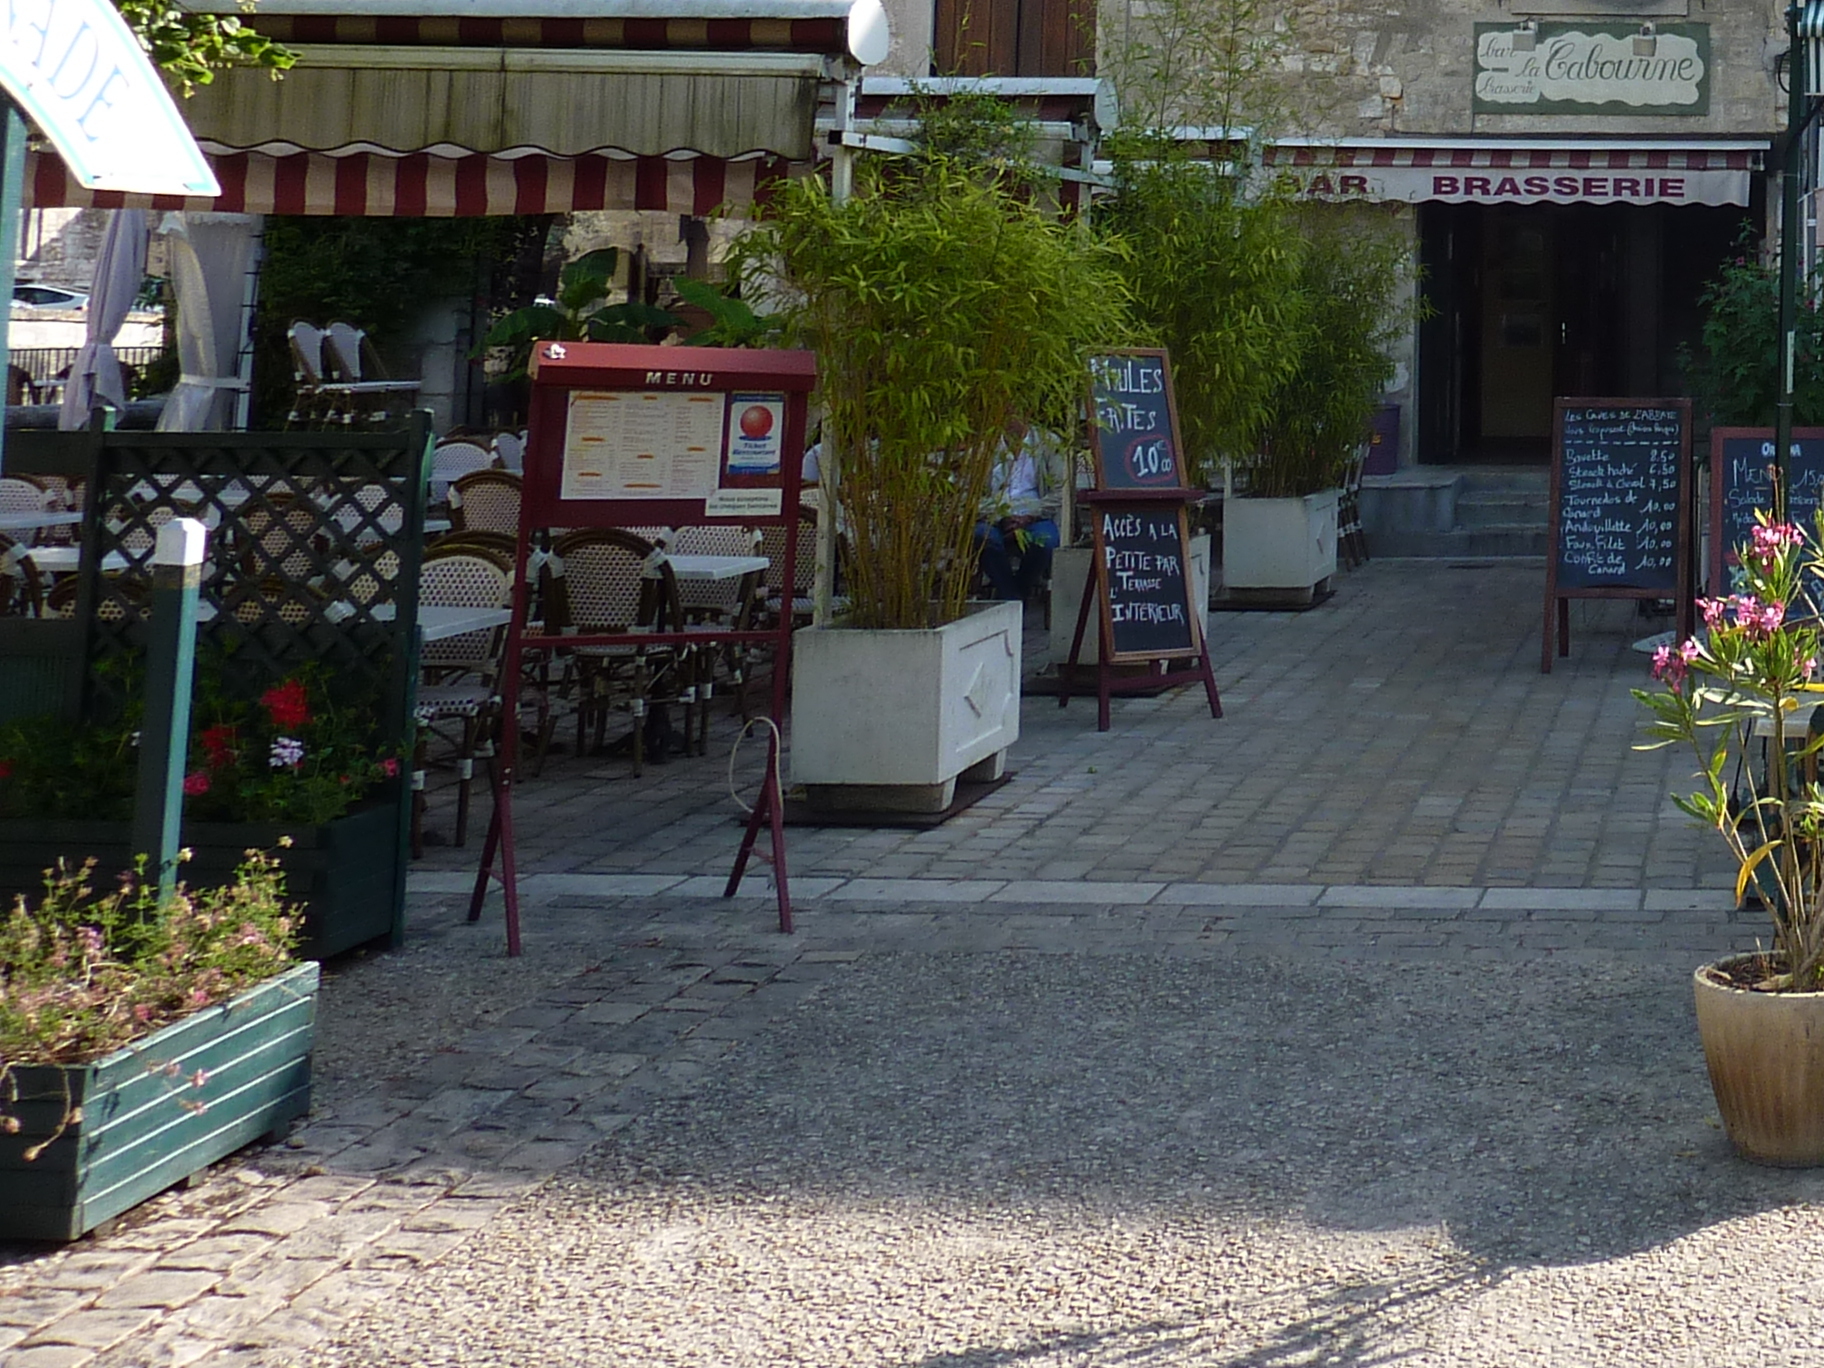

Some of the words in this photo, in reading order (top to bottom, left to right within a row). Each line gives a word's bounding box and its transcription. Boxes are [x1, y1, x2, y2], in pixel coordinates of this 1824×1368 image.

[1515, 57, 1542, 78] la
[1544, 38, 1696, 82] Cabourne
[1478, 76, 1537, 96] brasserie
[1432, 175, 1686, 198] BRASSERIE
[645, 371, 714, 386] MENU
[1625, 490, 1638, 504] de
[1728, 488, 1767, 509] Salade
[1161, 523, 1178, 540] LA
[1155, 555, 1180, 577] PAR
